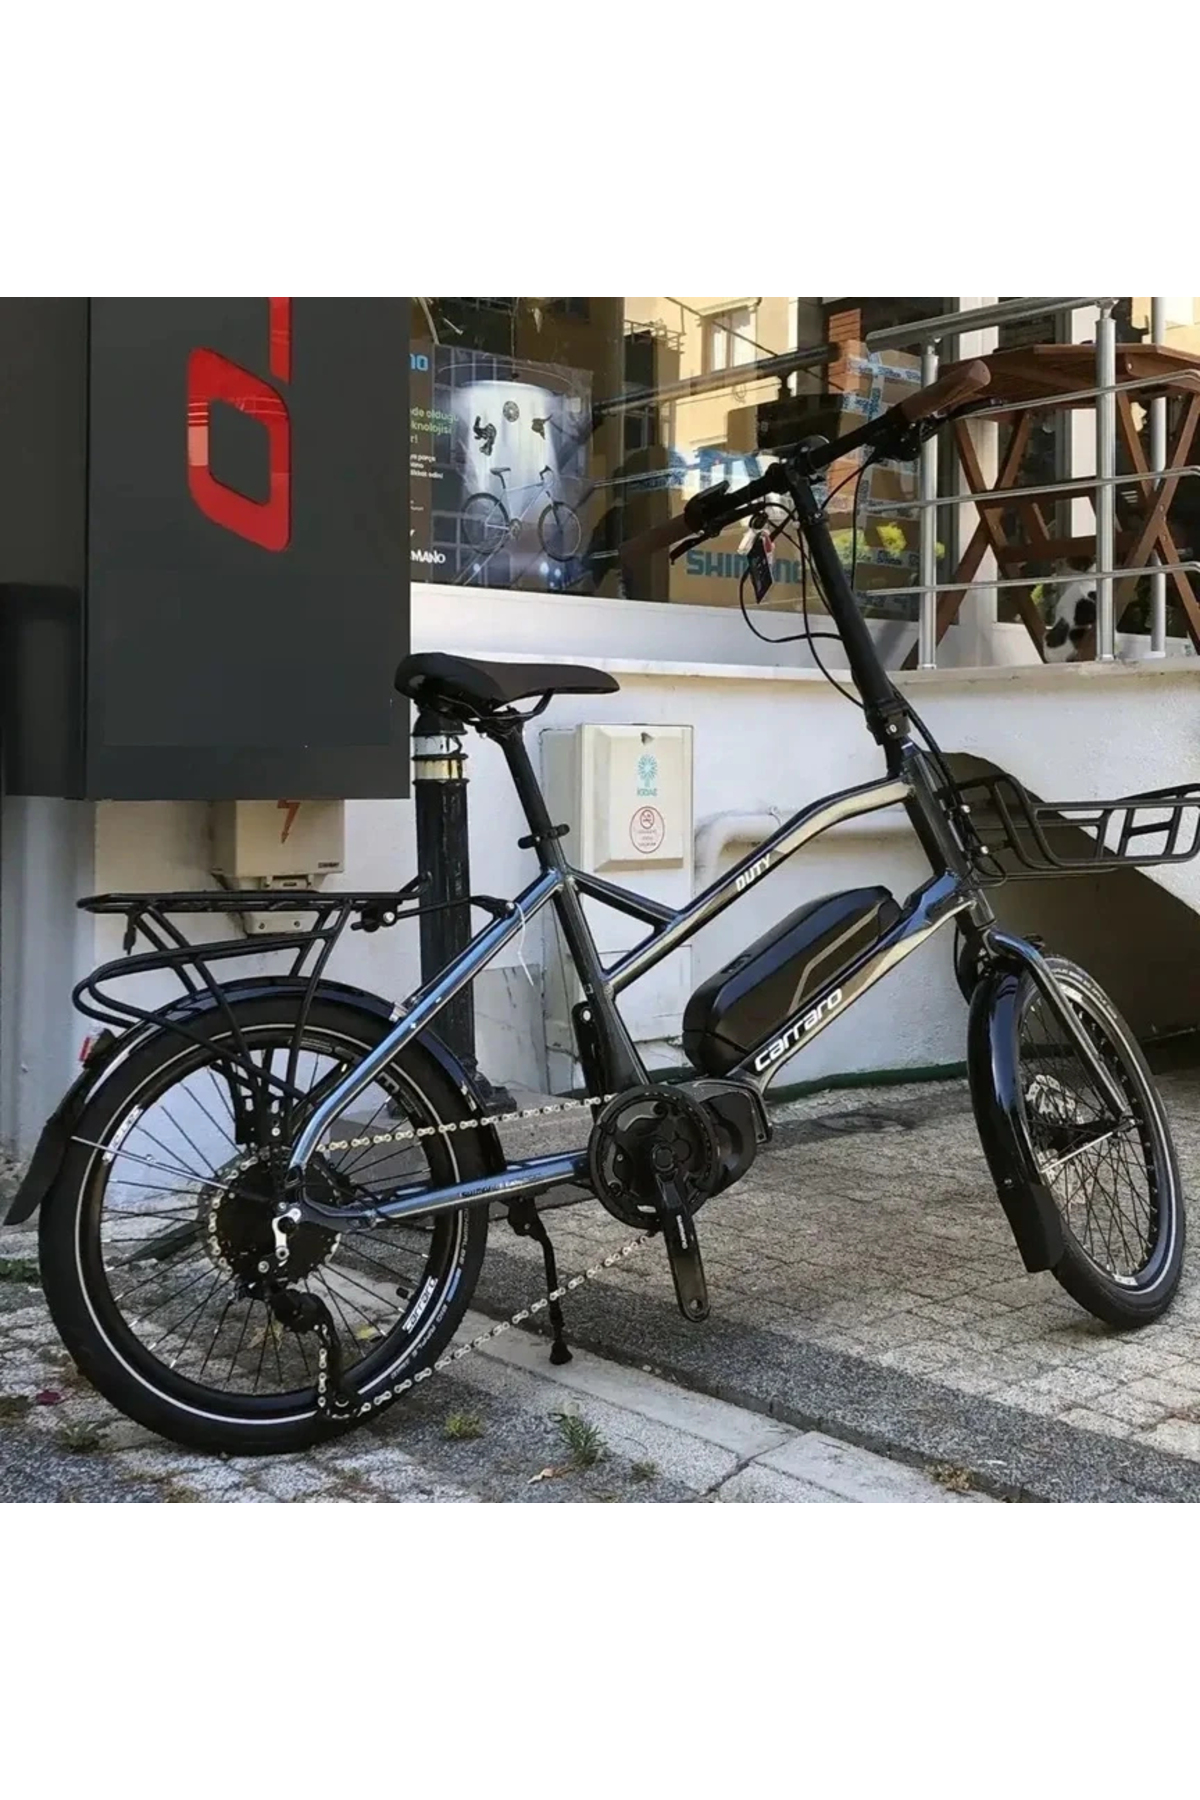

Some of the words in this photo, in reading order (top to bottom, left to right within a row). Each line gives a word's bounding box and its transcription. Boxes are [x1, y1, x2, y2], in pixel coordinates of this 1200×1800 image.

[686, 549, 806, 584] SHIMNO
[735, 853, 771, 892] DUTY
[754, 987, 843, 1072] carraro
[460, 1207, 470, 1265] CHWALBE
